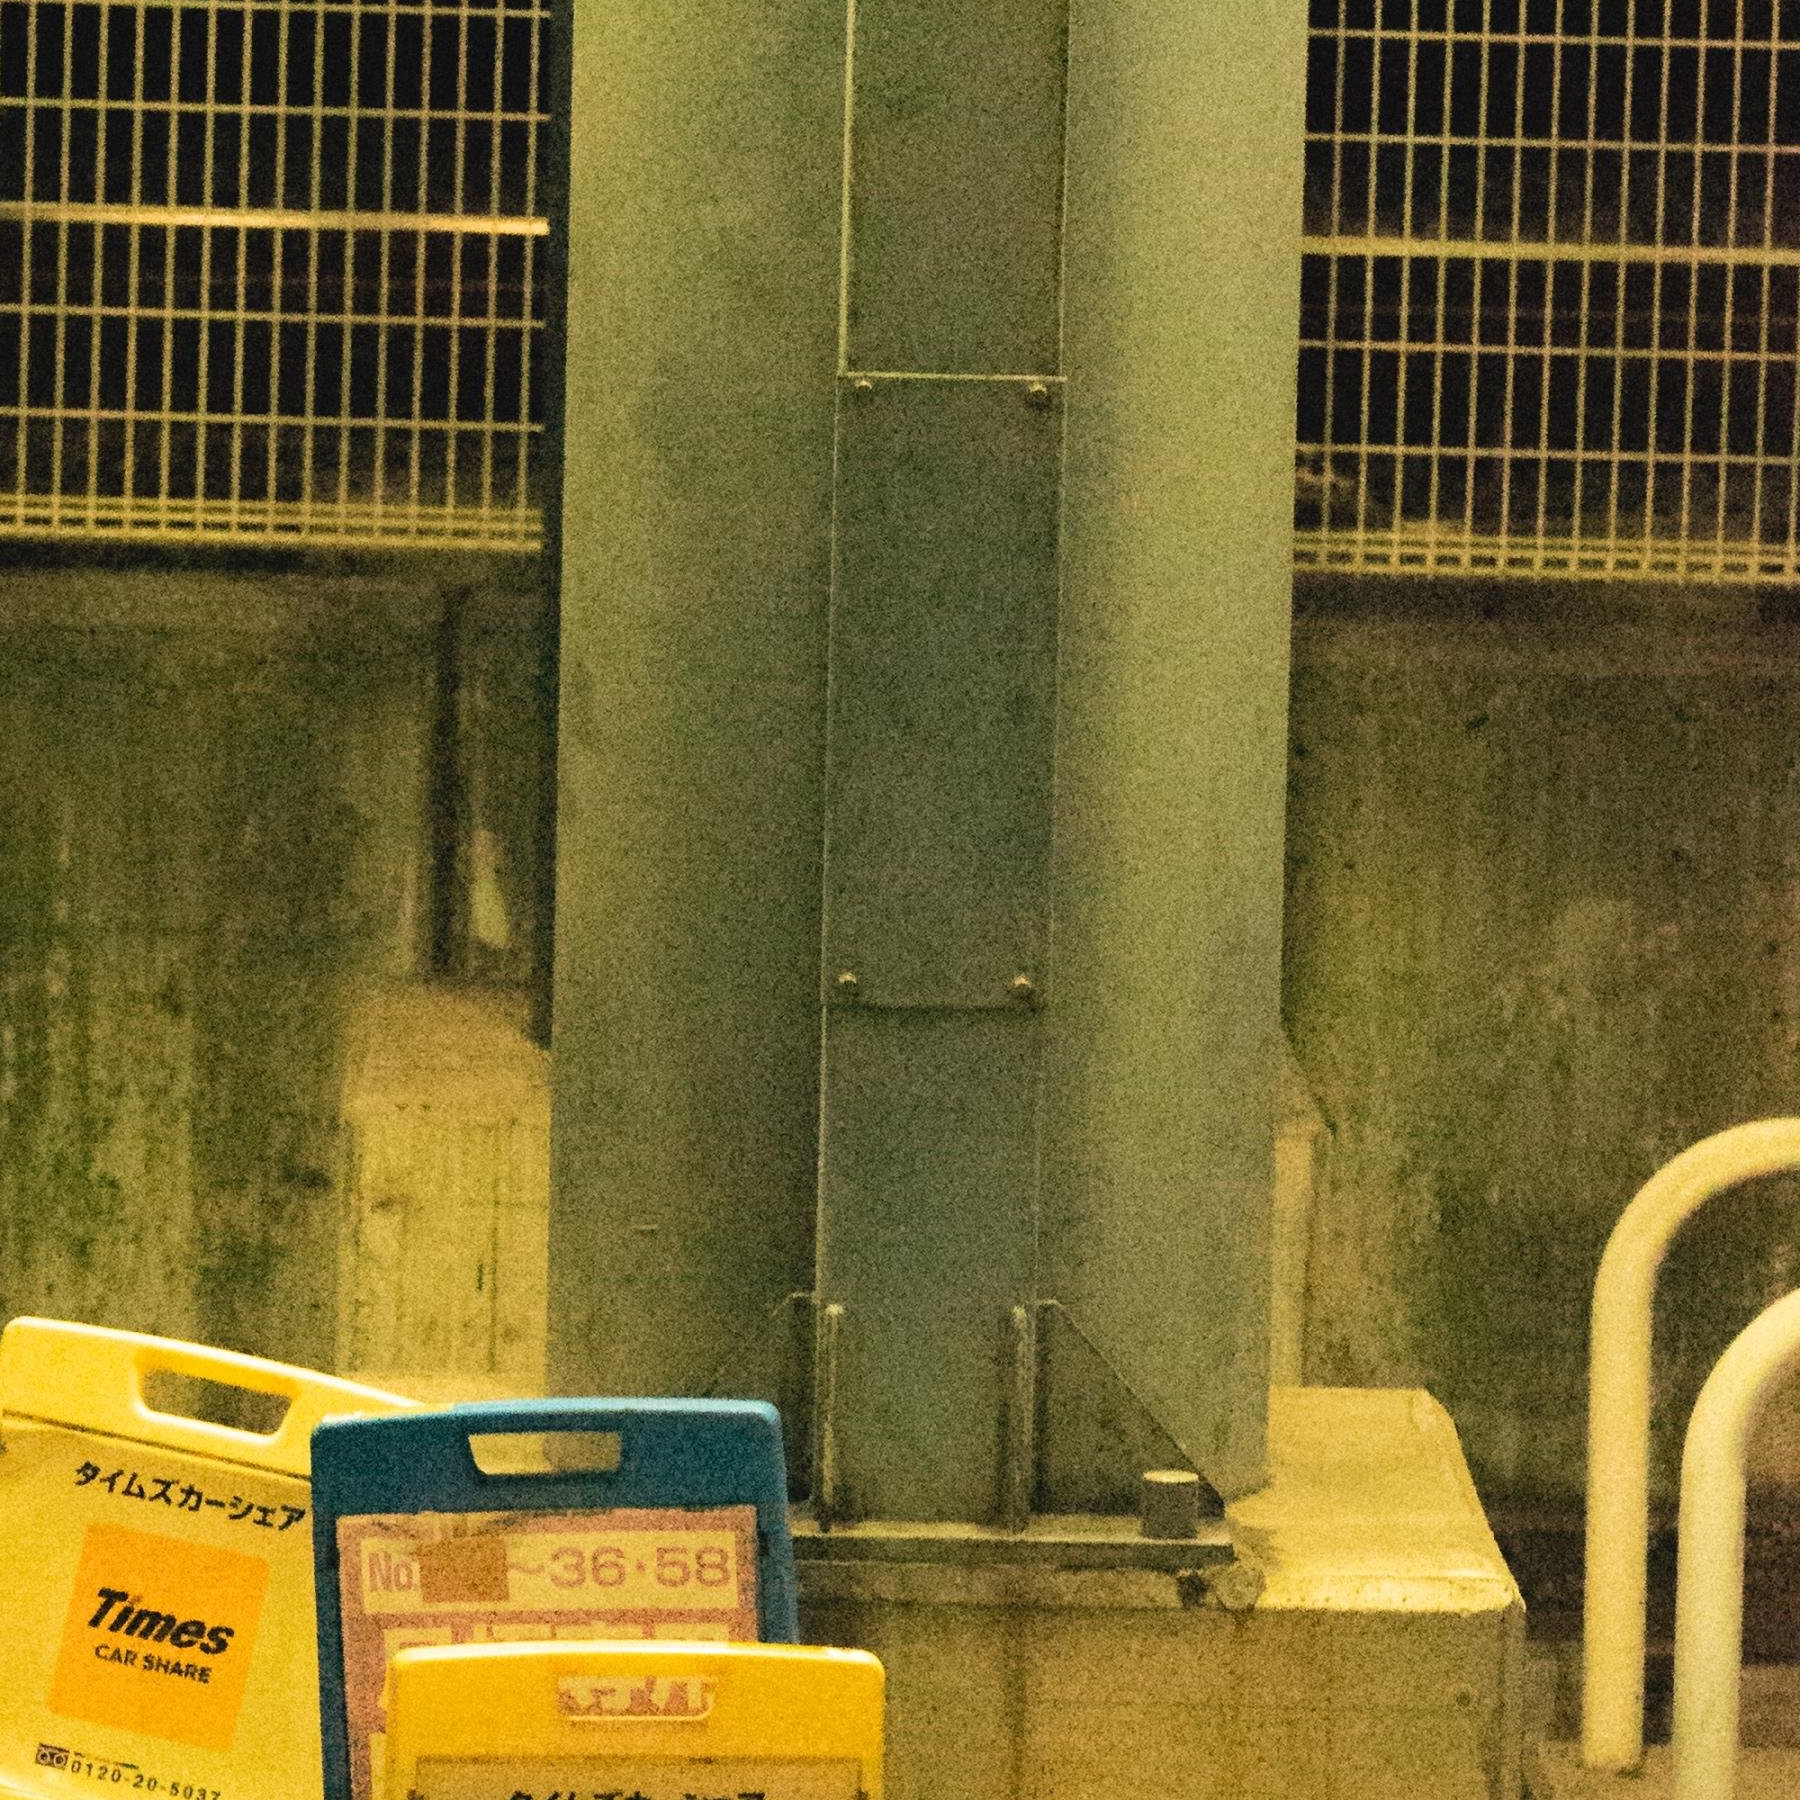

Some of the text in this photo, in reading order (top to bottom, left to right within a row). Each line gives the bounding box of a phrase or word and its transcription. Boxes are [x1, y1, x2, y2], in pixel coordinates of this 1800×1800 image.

[76, 1460, 306, 1531] タイムズカーシェア
[88, 1587, 235, 1654] Times
[94, 1643, 212, 1684] CAR SHARE
